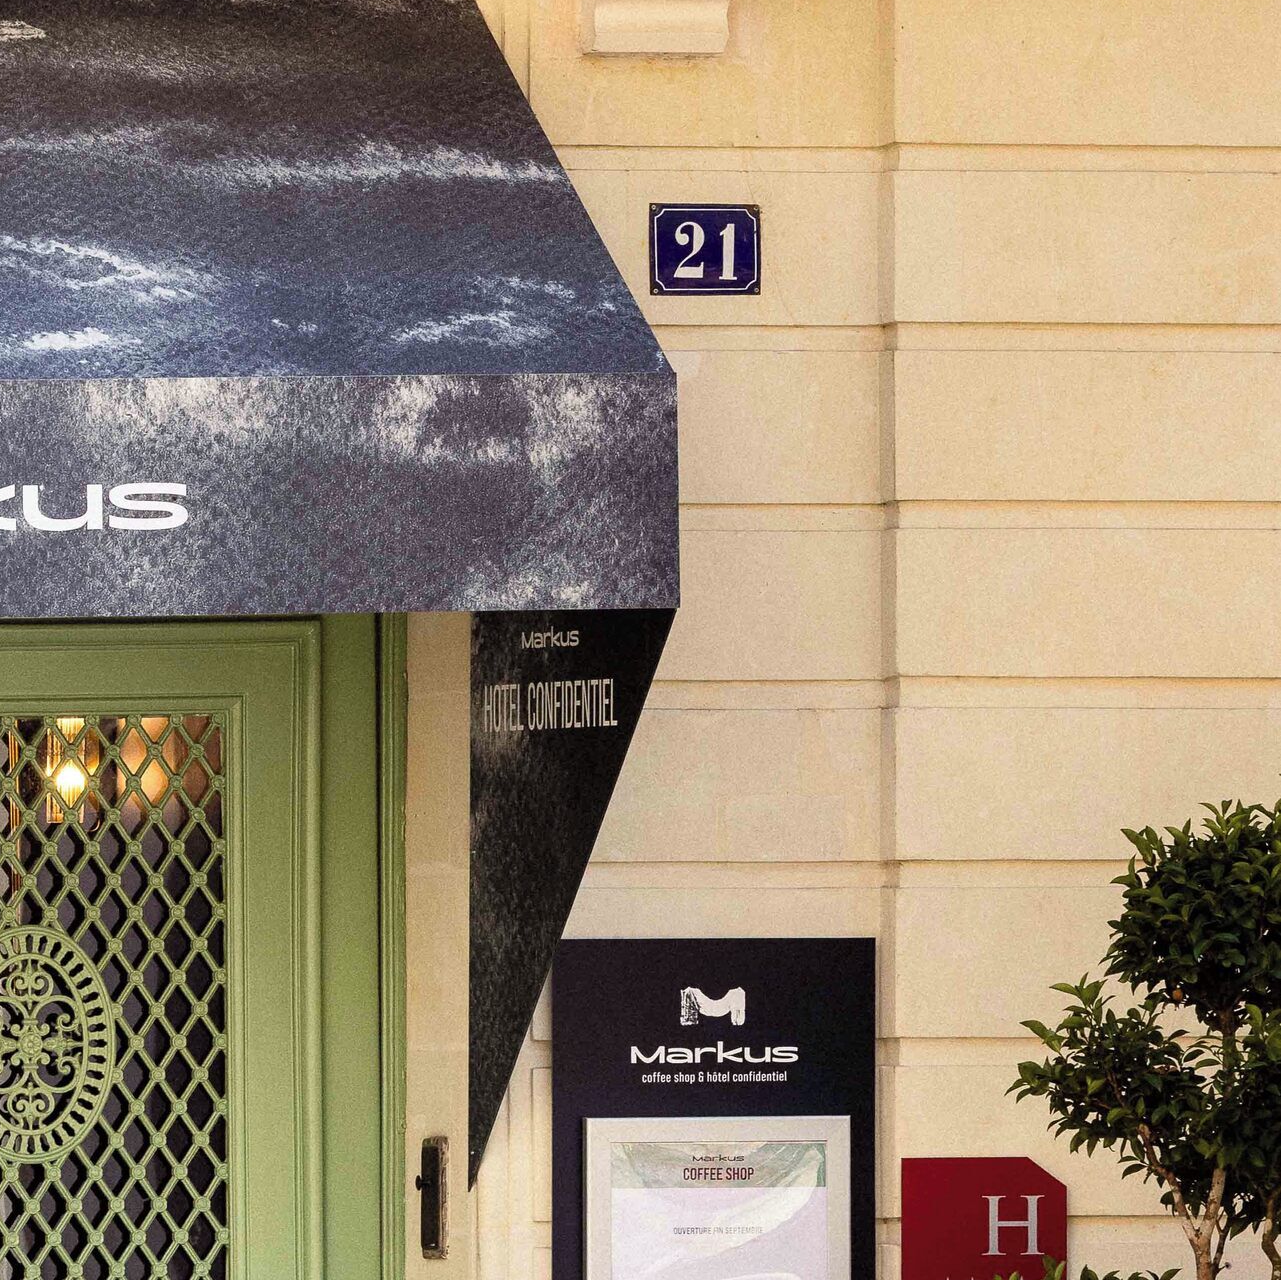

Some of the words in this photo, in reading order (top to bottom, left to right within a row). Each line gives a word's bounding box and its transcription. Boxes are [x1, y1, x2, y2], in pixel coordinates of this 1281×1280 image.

[673, 221, 738, 280] 21
[521, 626, 580, 649] Markus
[484, 683, 524, 732] HOTEL
[527, 678, 618, 731] CONFIDENTIEL
[630, 1041, 799, 1064] Markus
[642, 1072, 671, 1083] coffee
[674, 1071, 696, 1084] shop
[698, 1071, 704, 1082] &
[706, 1071, 730, 1082] hôtel
[732, 1070, 788, 1082] confidentiel
[692, 1154, 745, 1162] Markus
[683, 1167, 723, 1181] COFFEE
[725, 1167, 755, 1181] SHOP
[673, 1227, 712, 1235] OUVERTURE
[981, 1194, 1046, 1256] H
